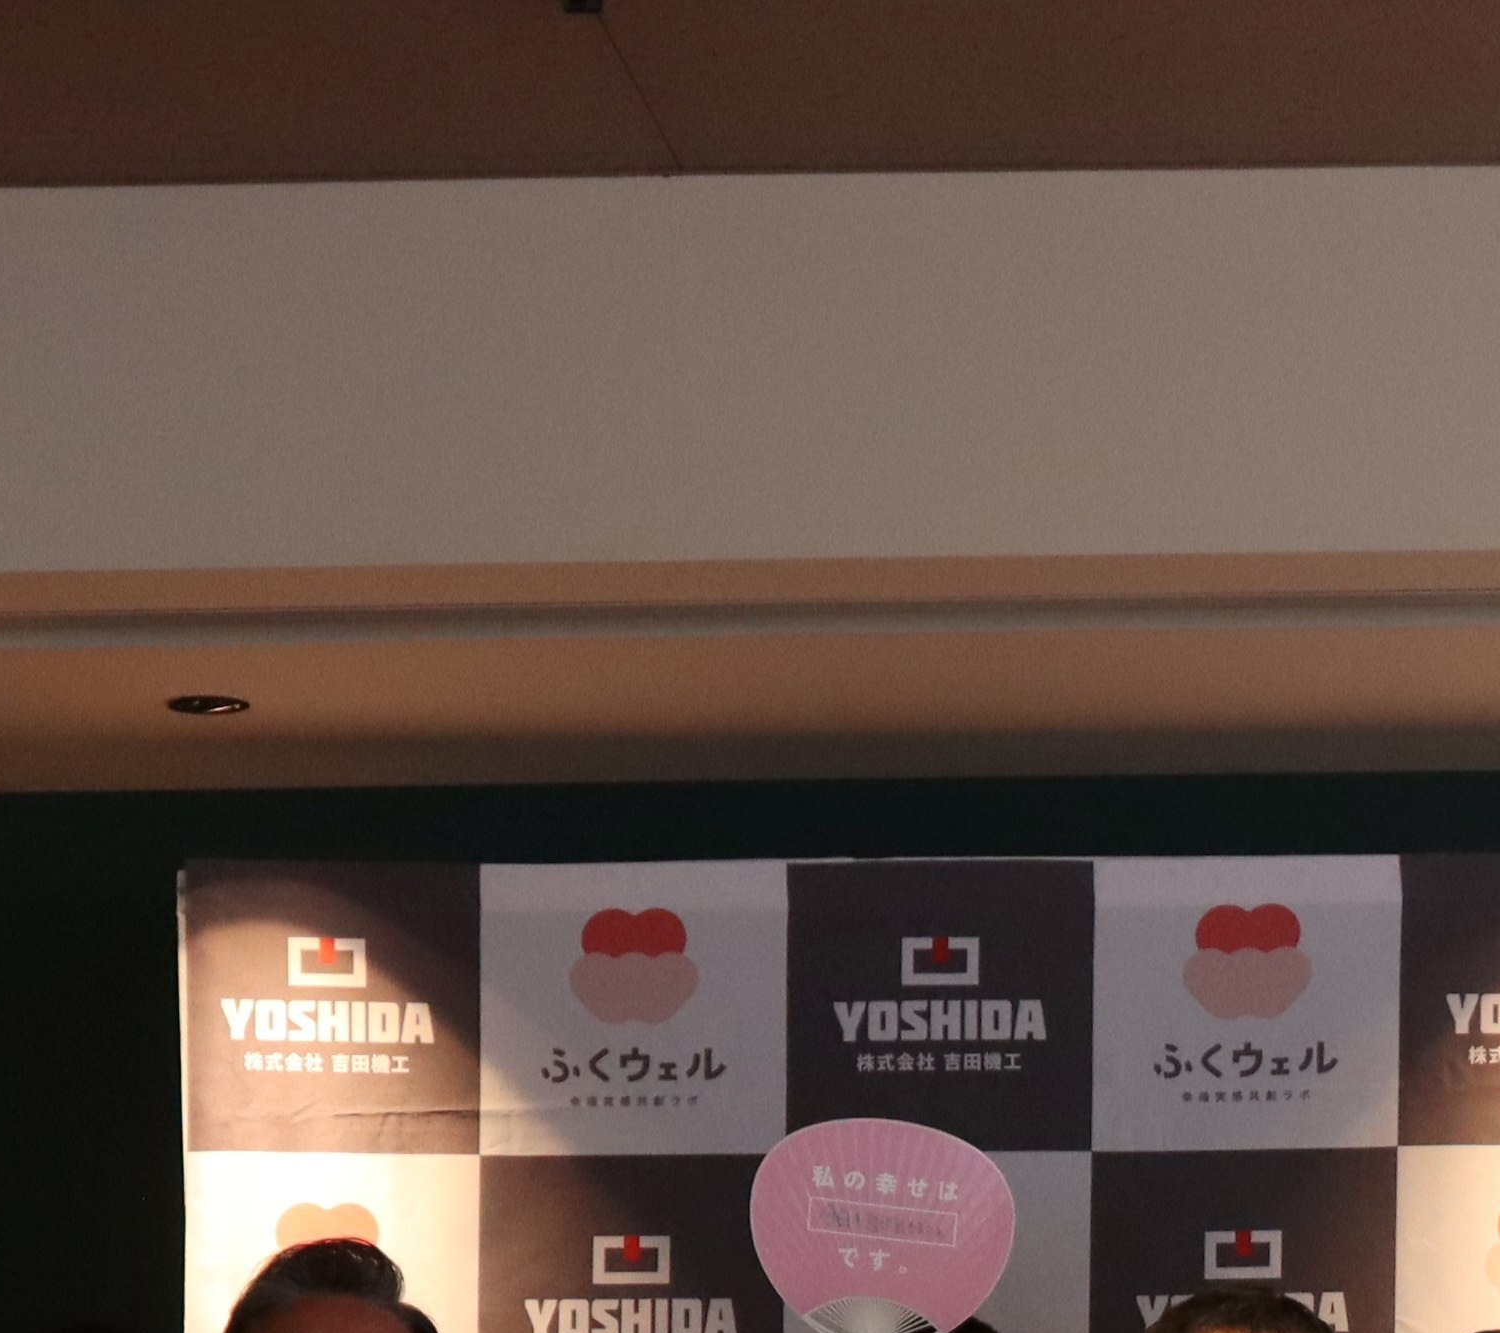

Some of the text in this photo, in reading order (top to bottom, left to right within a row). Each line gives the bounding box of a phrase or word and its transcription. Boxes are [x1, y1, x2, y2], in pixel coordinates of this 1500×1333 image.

[221, 998, 435, 1044] YOSHIDA
[833, 998, 1047, 1044] YOSHIDA
[243, 1051, 410, 1074] 株式会社 吉田機工
[541, 1046, 727, 1083] ふくウェル
[855, 1050, 1022, 1072] 株式会社 吉田機工
[1153, 1041, 1338, 1079] ふくウェル
[812, 1165, 959, 1201] 私の幸せは
[838, 1248, 908, 1274] です。
